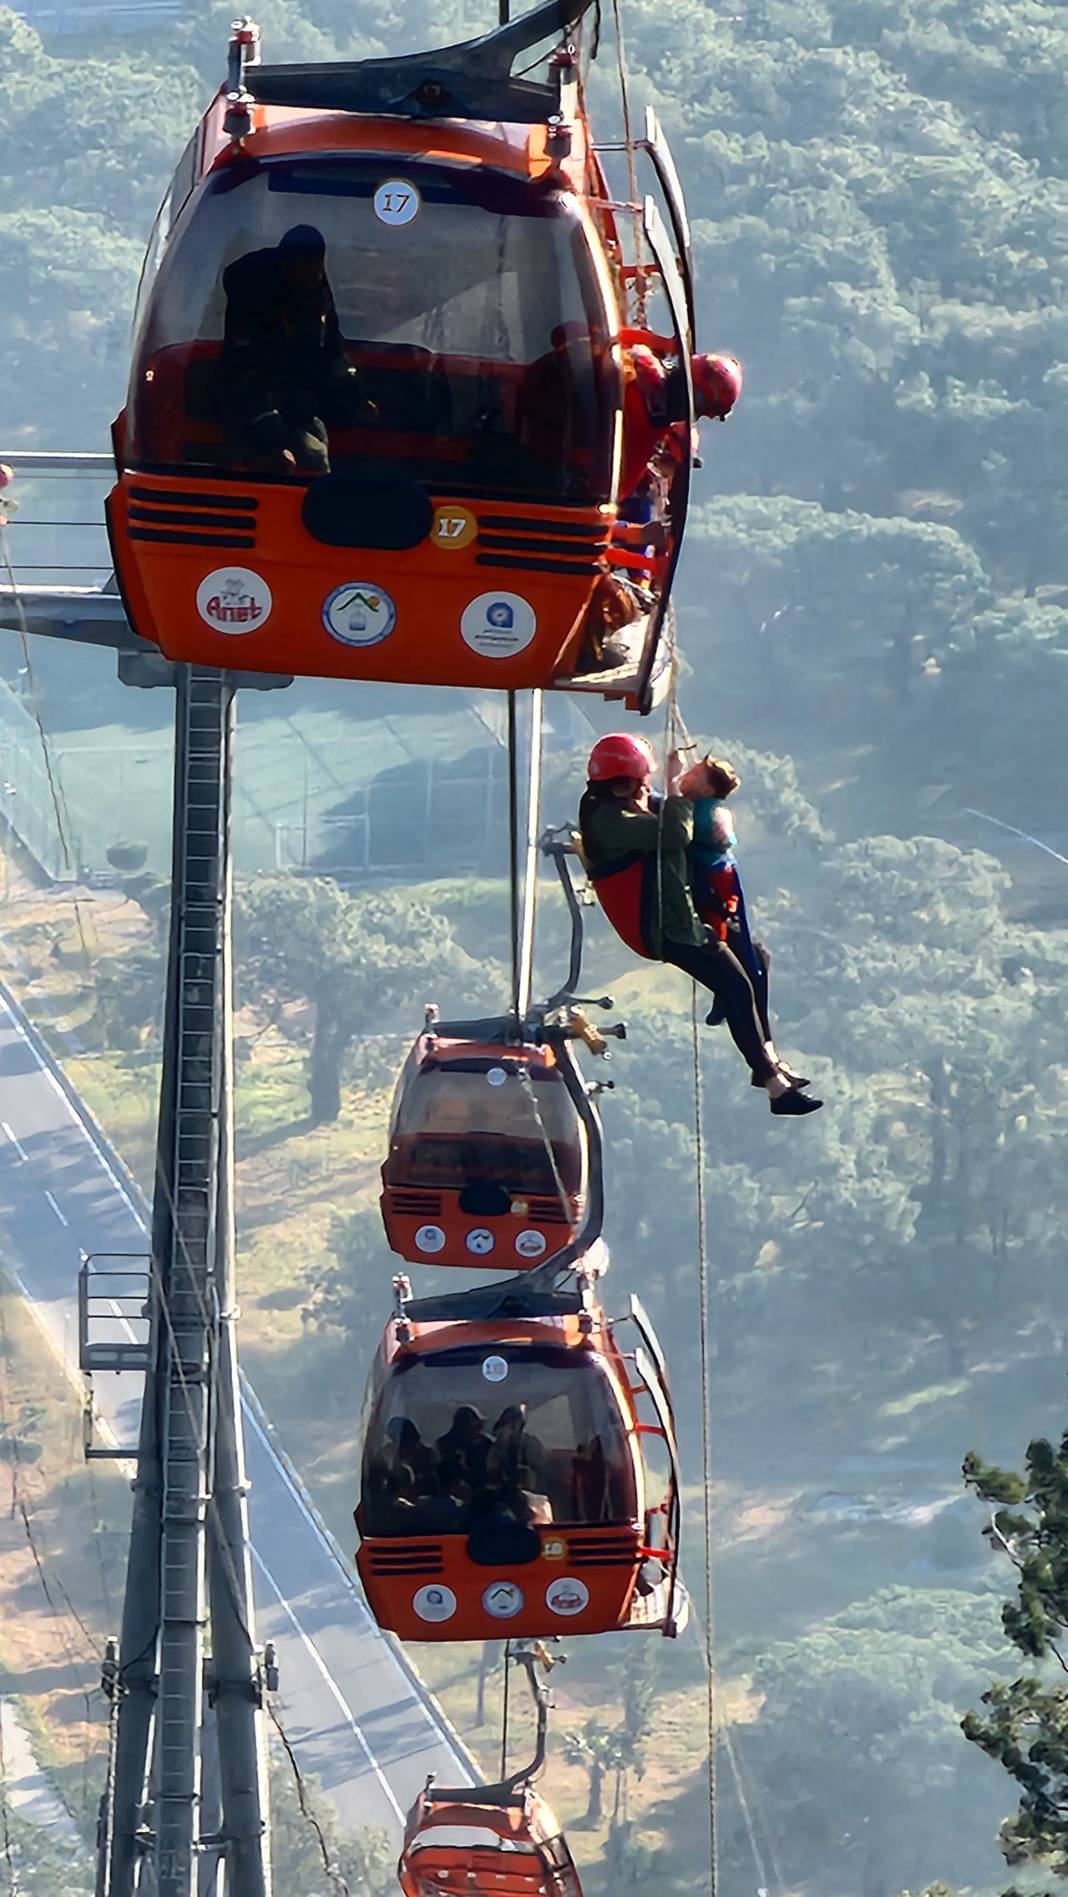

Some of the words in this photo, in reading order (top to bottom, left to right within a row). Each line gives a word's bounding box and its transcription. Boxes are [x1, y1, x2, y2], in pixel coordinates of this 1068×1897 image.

[382, 193, 410, 213] 17
[438, 518, 466, 537] 17
[206, 596, 263, 623] Anet
